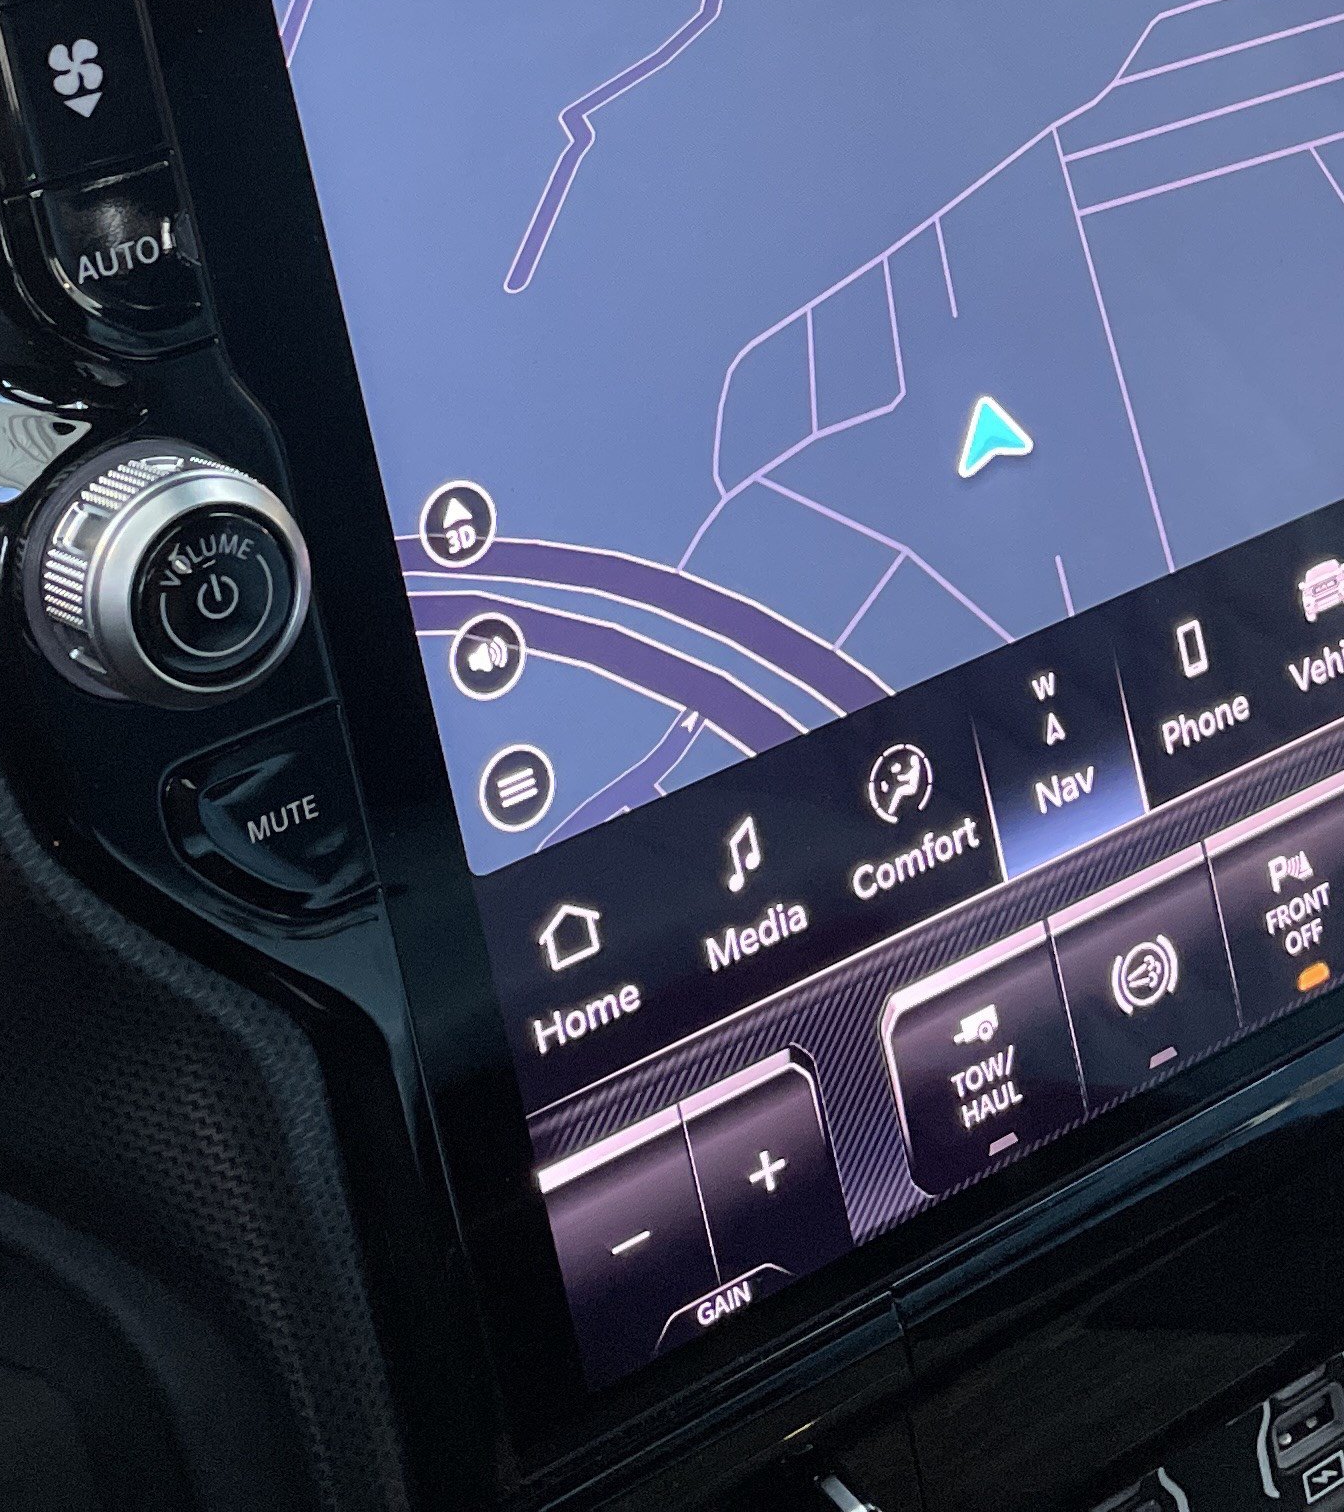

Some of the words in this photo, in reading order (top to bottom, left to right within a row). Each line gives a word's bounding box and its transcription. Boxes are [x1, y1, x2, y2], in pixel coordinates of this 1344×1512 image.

[76, 235, 159, 284] AUTO
[159, 533, 255, 586] VOLUME
[445, 525, 477, 555] 3D
[1031, 671, 1056, 701] W
[1161, 693, 1251, 755] Phone
[1035, 766, 1097, 814] Nav
[246, 794, 319, 844] MUTE
[853, 816, 980, 900] Comfort
[1265, 881, 1331, 936] FRONT
[706, 901, 809, 973] Media
[1284, 919, 1324, 957] OFF
[533, 982, 642, 1054] Home
[950, 1043, 1016, 1100] TOW/
[960, 1081, 1024, 1130] HAUL
[696, 1280, 751, 1326] GAIN
